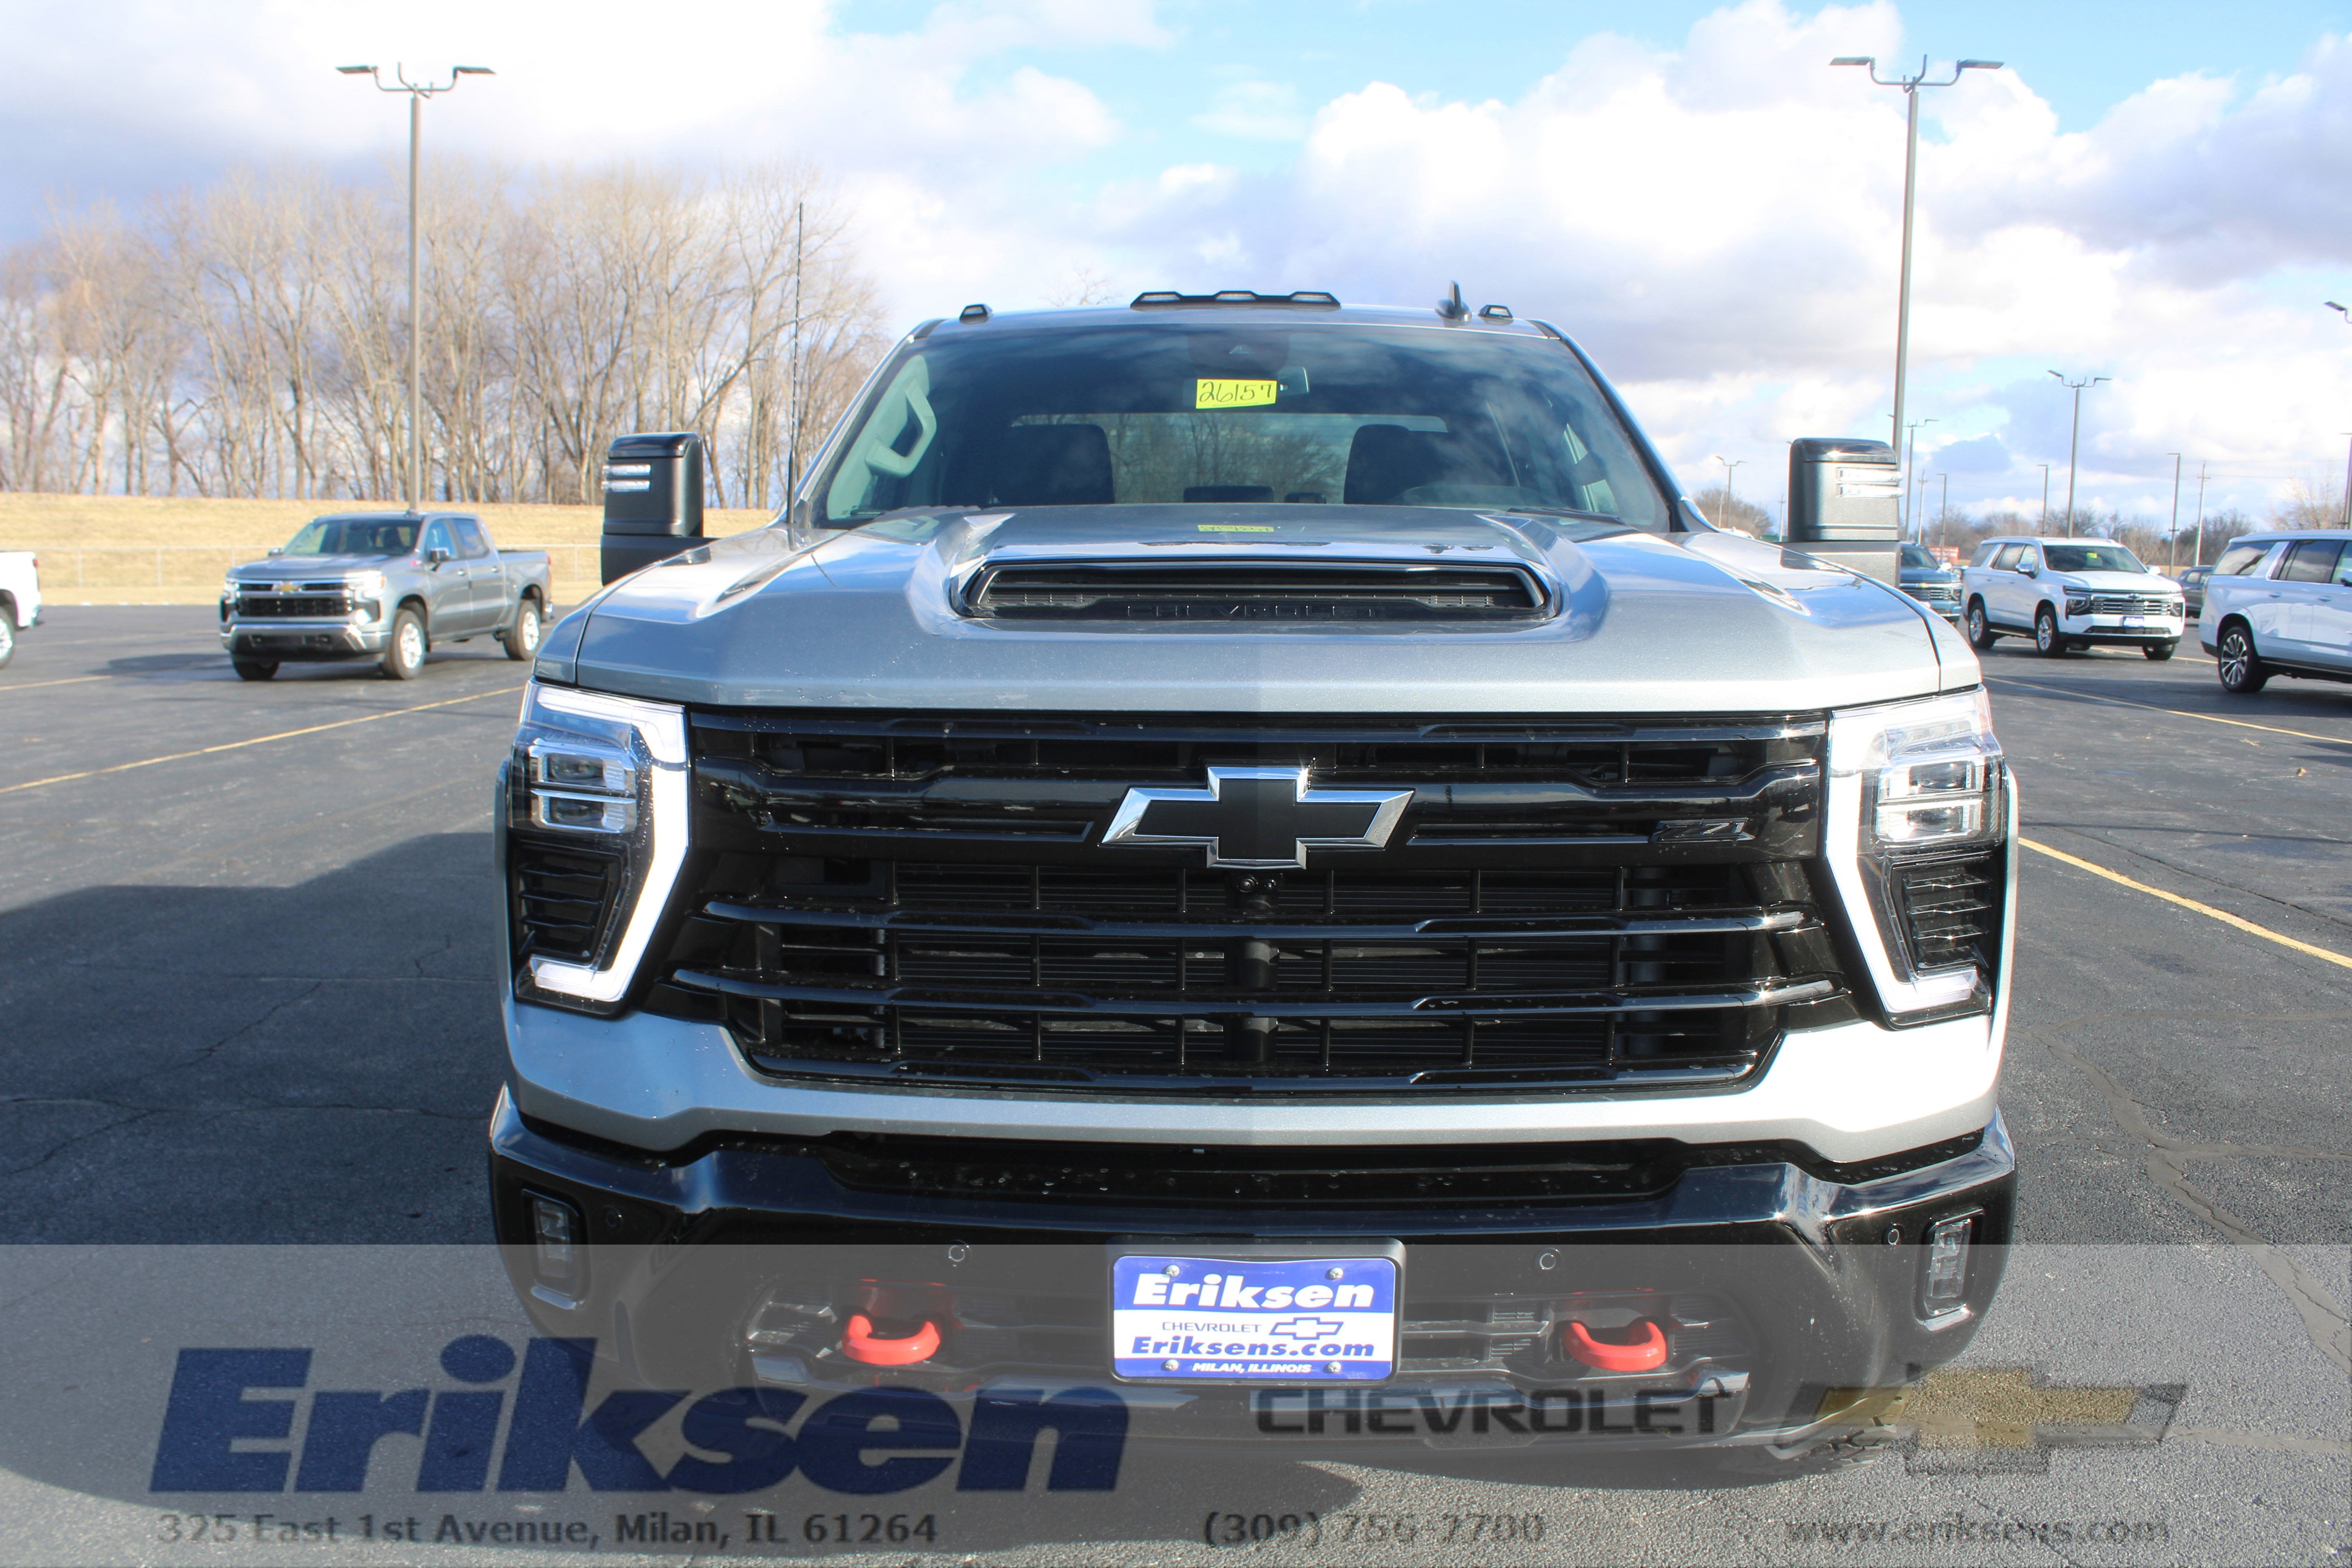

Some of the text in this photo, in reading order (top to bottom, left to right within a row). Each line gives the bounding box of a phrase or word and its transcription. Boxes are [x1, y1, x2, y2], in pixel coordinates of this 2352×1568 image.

[1199, 381, 1274, 403] 26157
[1133, 1273, 1374, 1309] Eriksen
[1162, 1321, 1262, 1333] CHEVROLET
[1131, 1336, 1374, 1357] Eriksens.com
[1192, 1362, 1312, 1373] MILAN, ILLINOIS
